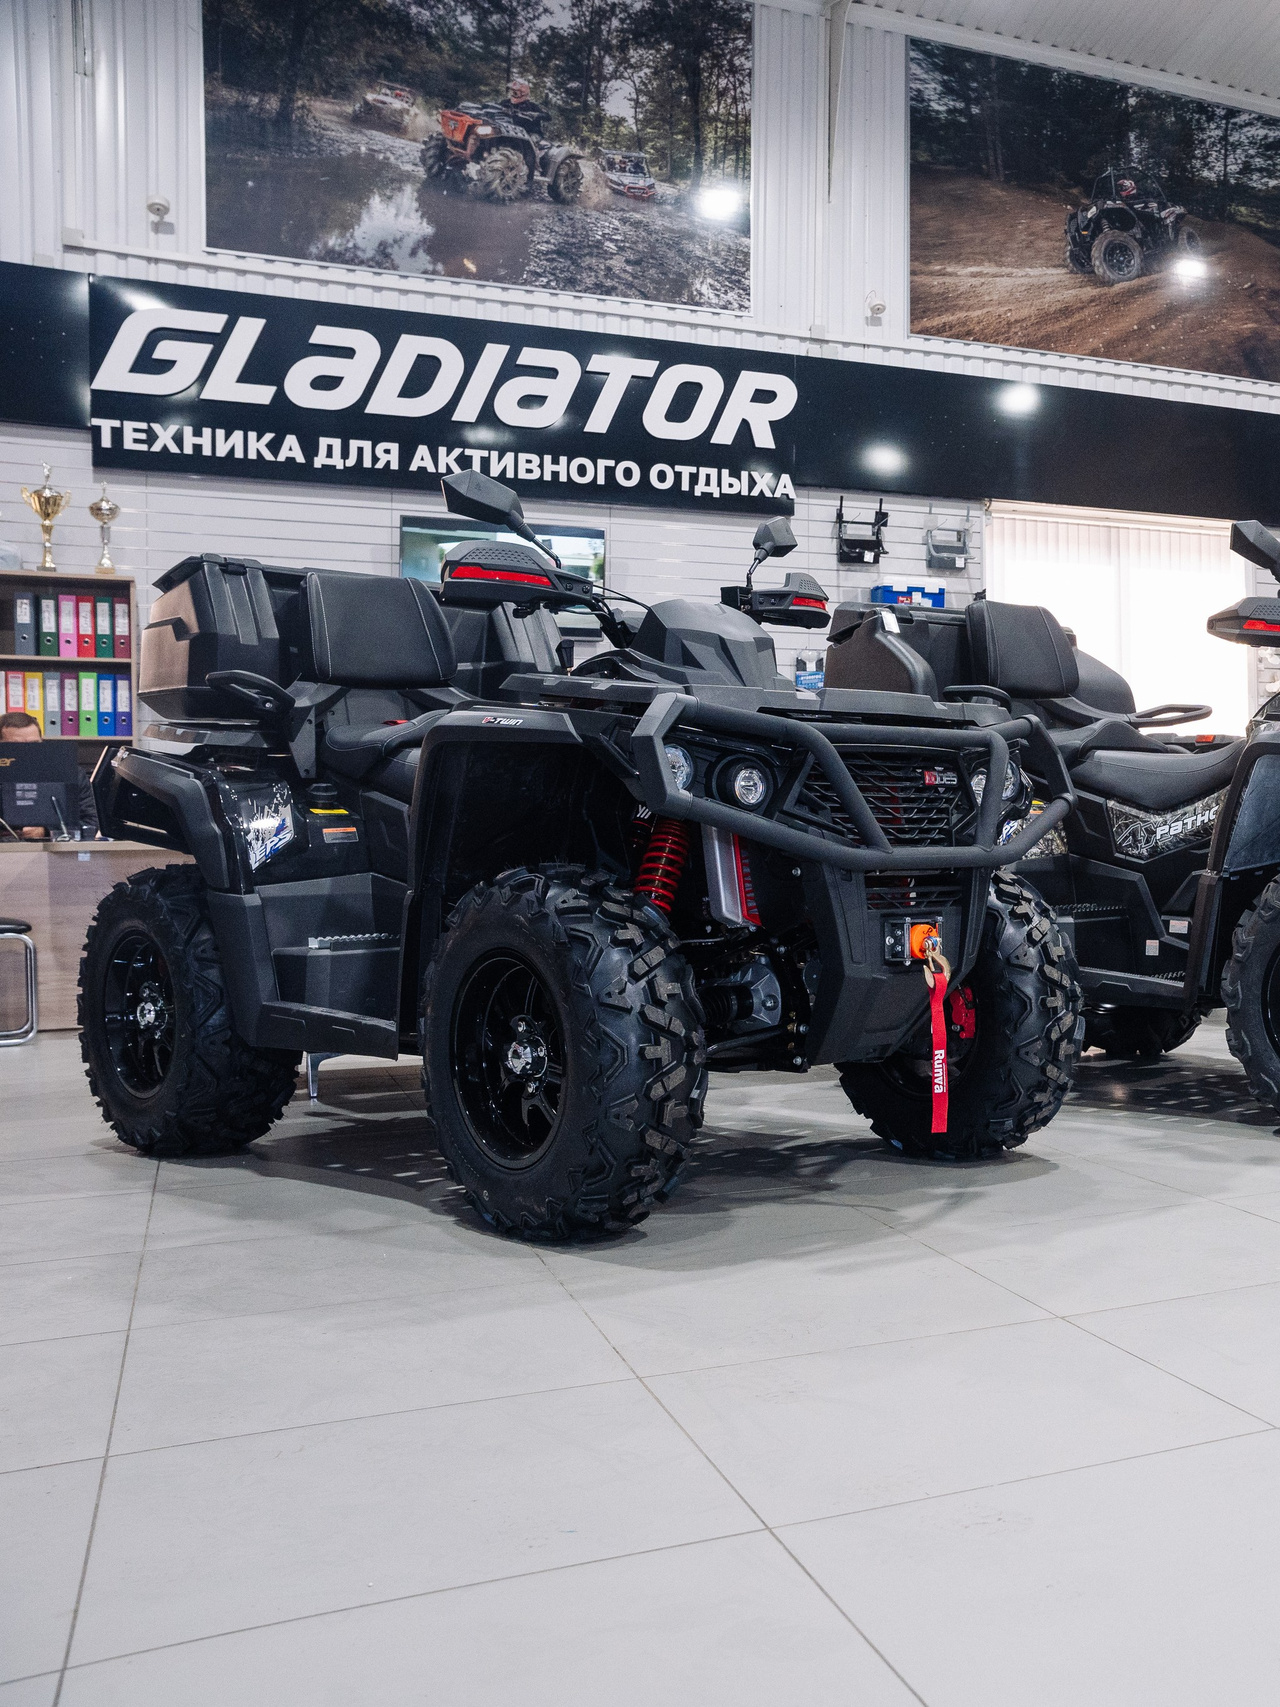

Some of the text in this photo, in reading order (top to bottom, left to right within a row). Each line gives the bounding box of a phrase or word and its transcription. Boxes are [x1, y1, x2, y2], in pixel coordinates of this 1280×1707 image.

[92, 417, 797, 499] ТЕХНИКА ДЛЯ АКТИВНОГО ОТДЫХА
[934, 1049, 945, 1094] Runva
